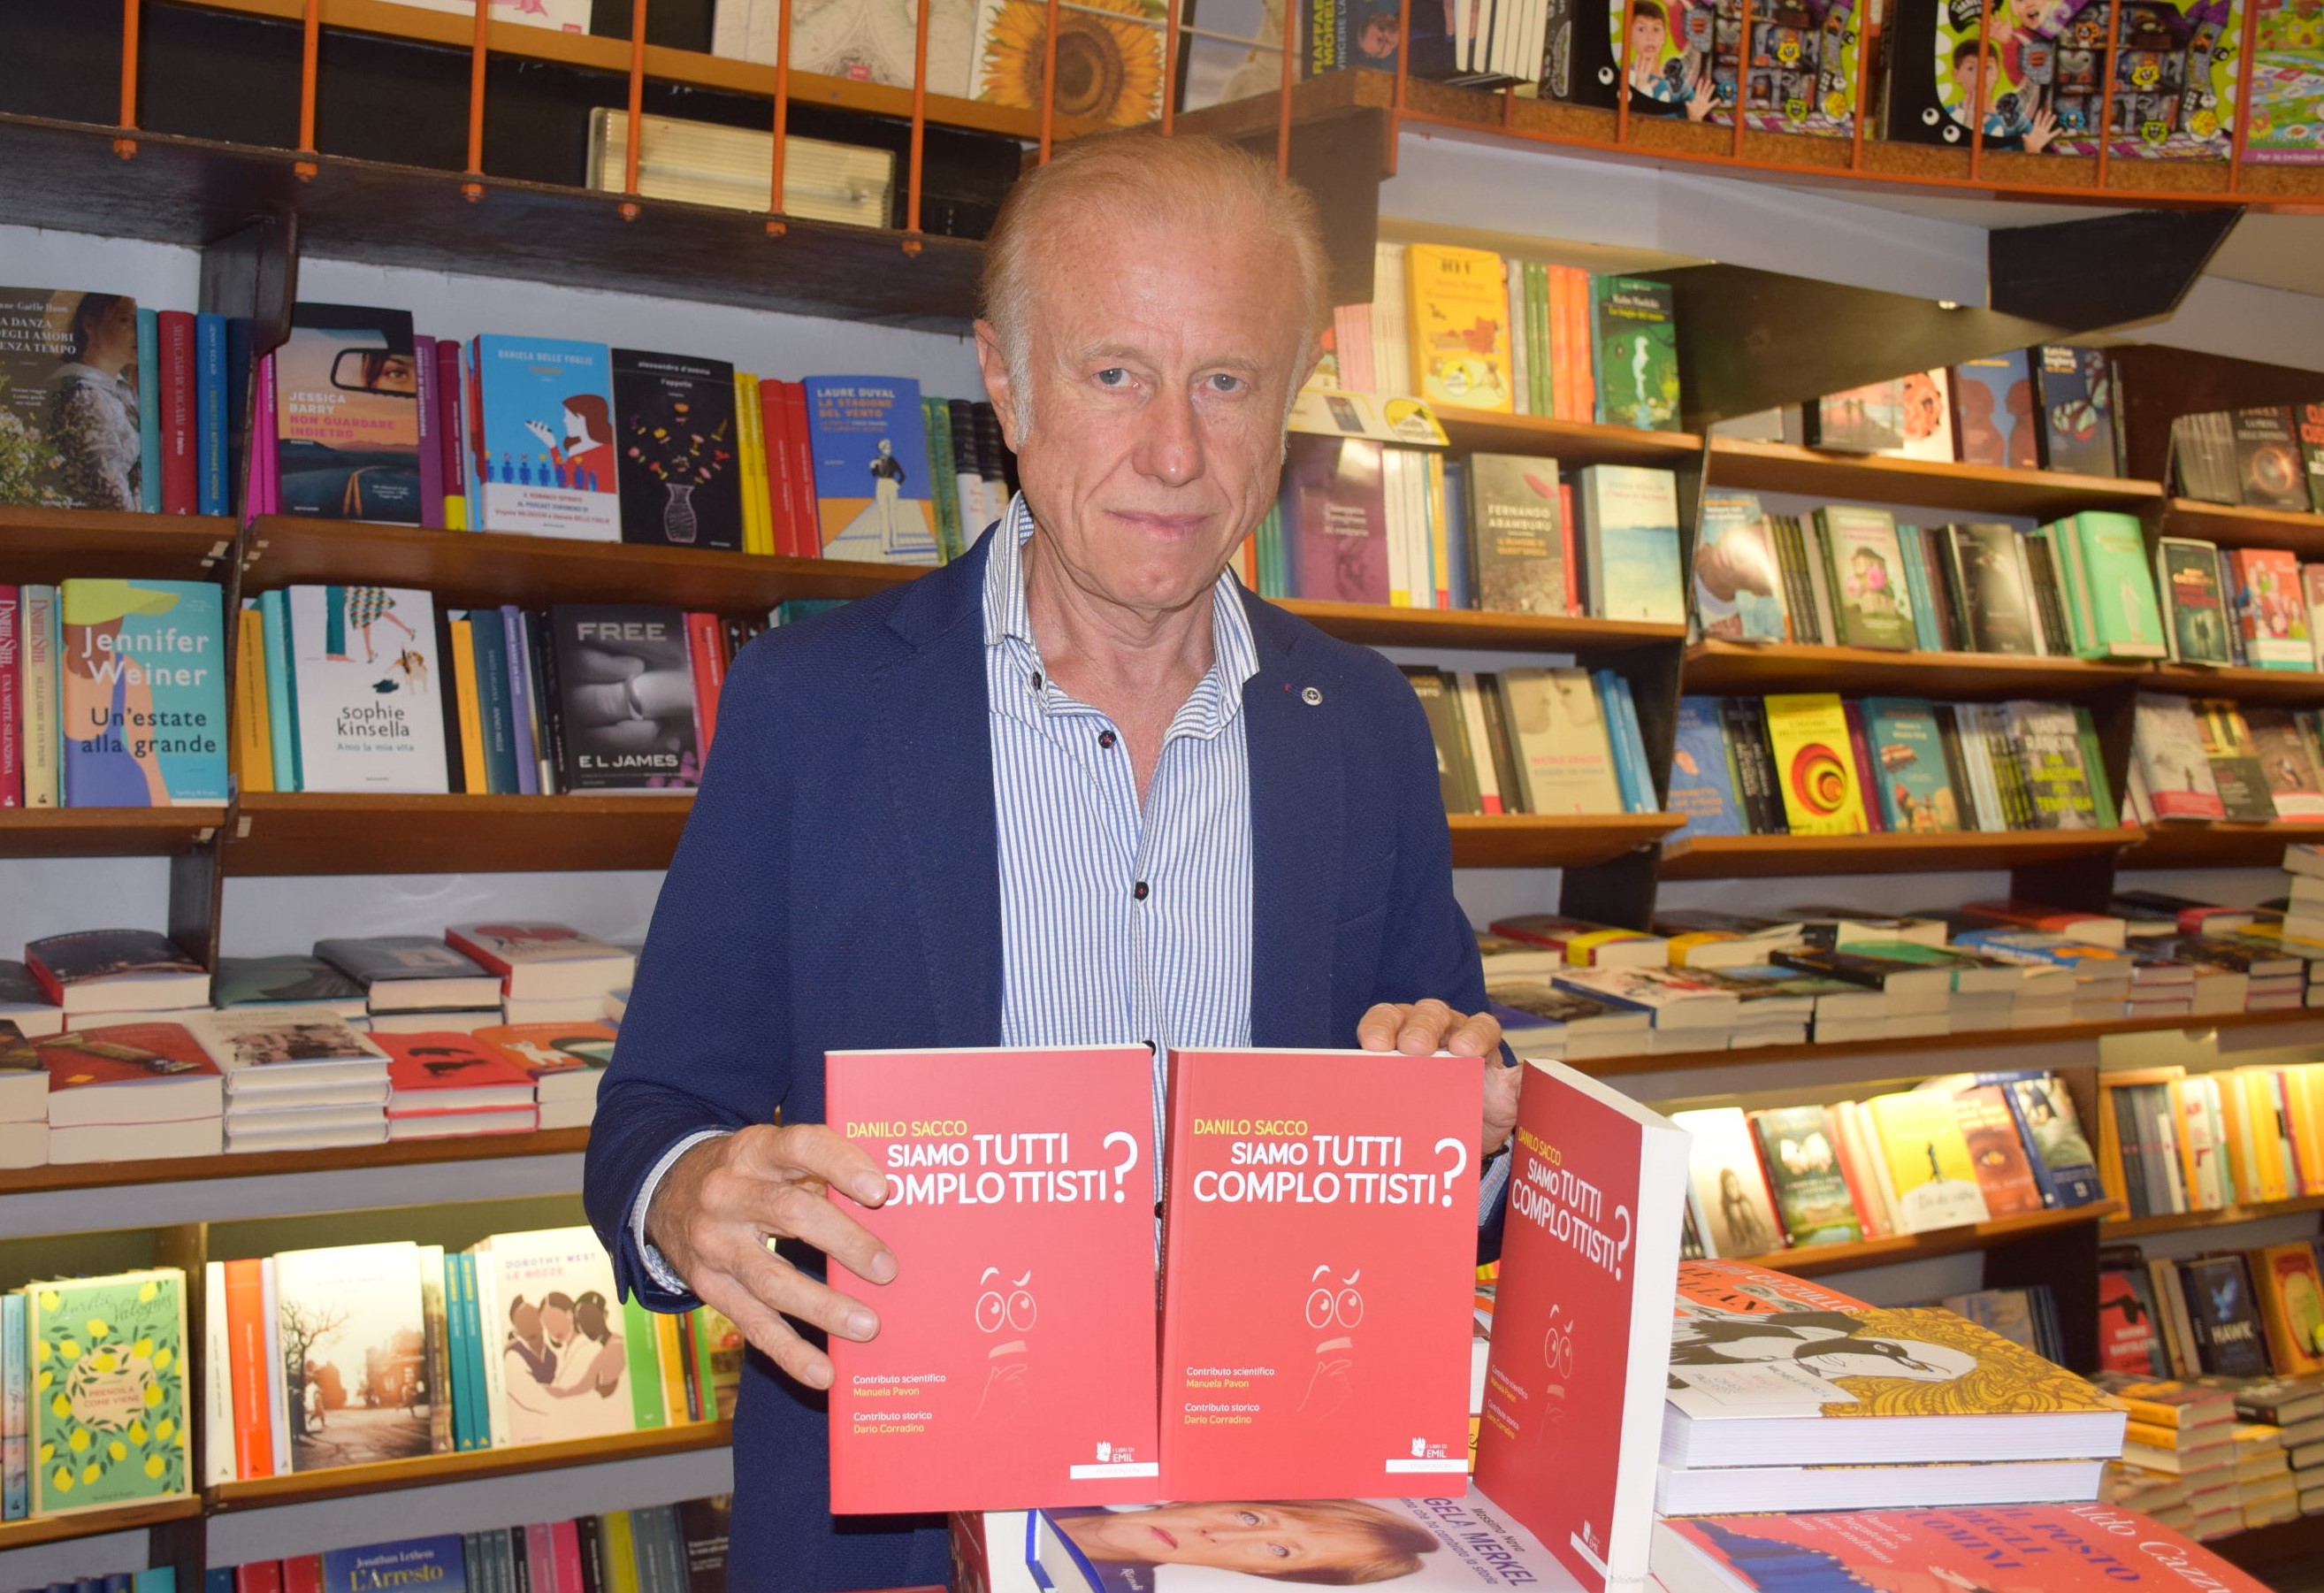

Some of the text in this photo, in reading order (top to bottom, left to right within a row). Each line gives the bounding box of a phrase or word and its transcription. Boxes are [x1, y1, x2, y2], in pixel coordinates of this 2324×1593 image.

[11, 318, 52, 329] DANZA
[33, 332, 74, 342] AMORI
[0, 341, 77, 355] ENZA TEMPO
[289, 391, 347, 404] JESSICA
[817, 387, 896, 399] LAURE DUVAL
[289, 402, 335, 415] BARRY
[290, 416, 396, 430] NON GUARDARE
[290, 427, 354, 439] INDIETRO
[577, 622, 668, 641] FREE
[81, 625, 210, 658] Jennifer
[87, 660, 208, 686] Weiner
[91, 707, 207, 727] Un'estate
[341, 701, 405, 724] sophie
[2, 674, 13, 775] UNA NOTTE SILENZIOSA
[337, 717, 410, 738] kinsella
[81, 734, 217, 758] alla grande
[337, 743, 361, 752] Amo
[578, 754, 678, 768] E L JAMES
[846, 1120, 967, 1138] DANILO SACCO
[1194, 1119, 1308, 1136] DANILO SACCO
[887, 1132, 1067, 1168] SIAMO TUTTI
[1231, 1135, 1402, 1167] SIAMO TUTTI
[1517, 1126, 1562, 1166] DANILO SACCO
[1527, 1157, 1602, 1222] SIAMO TUTTI
[506, 1252, 597, 1269] DOROTHY WEST
[1746, 1274, 1859, 1312] CAZZULLO
[2212, 1320, 2254, 1344] HAWK
[853, 1373, 946, 1385] Contributo scientifico
[1187, 1367, 1275, 1376] Contributo scientifico
[853, 1385, 920, 1397] Manuela Pavon
[1186, 1378, 1249, 1388] Manuela Pavon
[853, 1410, 932, 1421] Contributo storico
[1185, 1402, 1259, 1413] Contributo storico
[853, 1422, 924, 1434] Dario Corradino
[1184, 1414, 1251, 1425] Dario Corradino
[1112, 1453, 1135, 1463] EMIL
[1426, 1449, 1448, 1459] EMIL
[1472, 1507, 1525, 1552] Massimo Nava
[1950, 1509, 2049, 1553] DEGLI
[1423, 1497, 1538, 1586] GELA MERKEL
[1906, 1512, 2022, 1569] UOMINI
[356, 1551, 435, 1569] Jonathan Lethem
[1434, 1529, 1470, 1558] cambiato
[1472, 1564, 1498, 1584] storia
[2030, 1522, 2140, 1582] POSTO
[351, 1563, 444, 1592] L'Arresto
